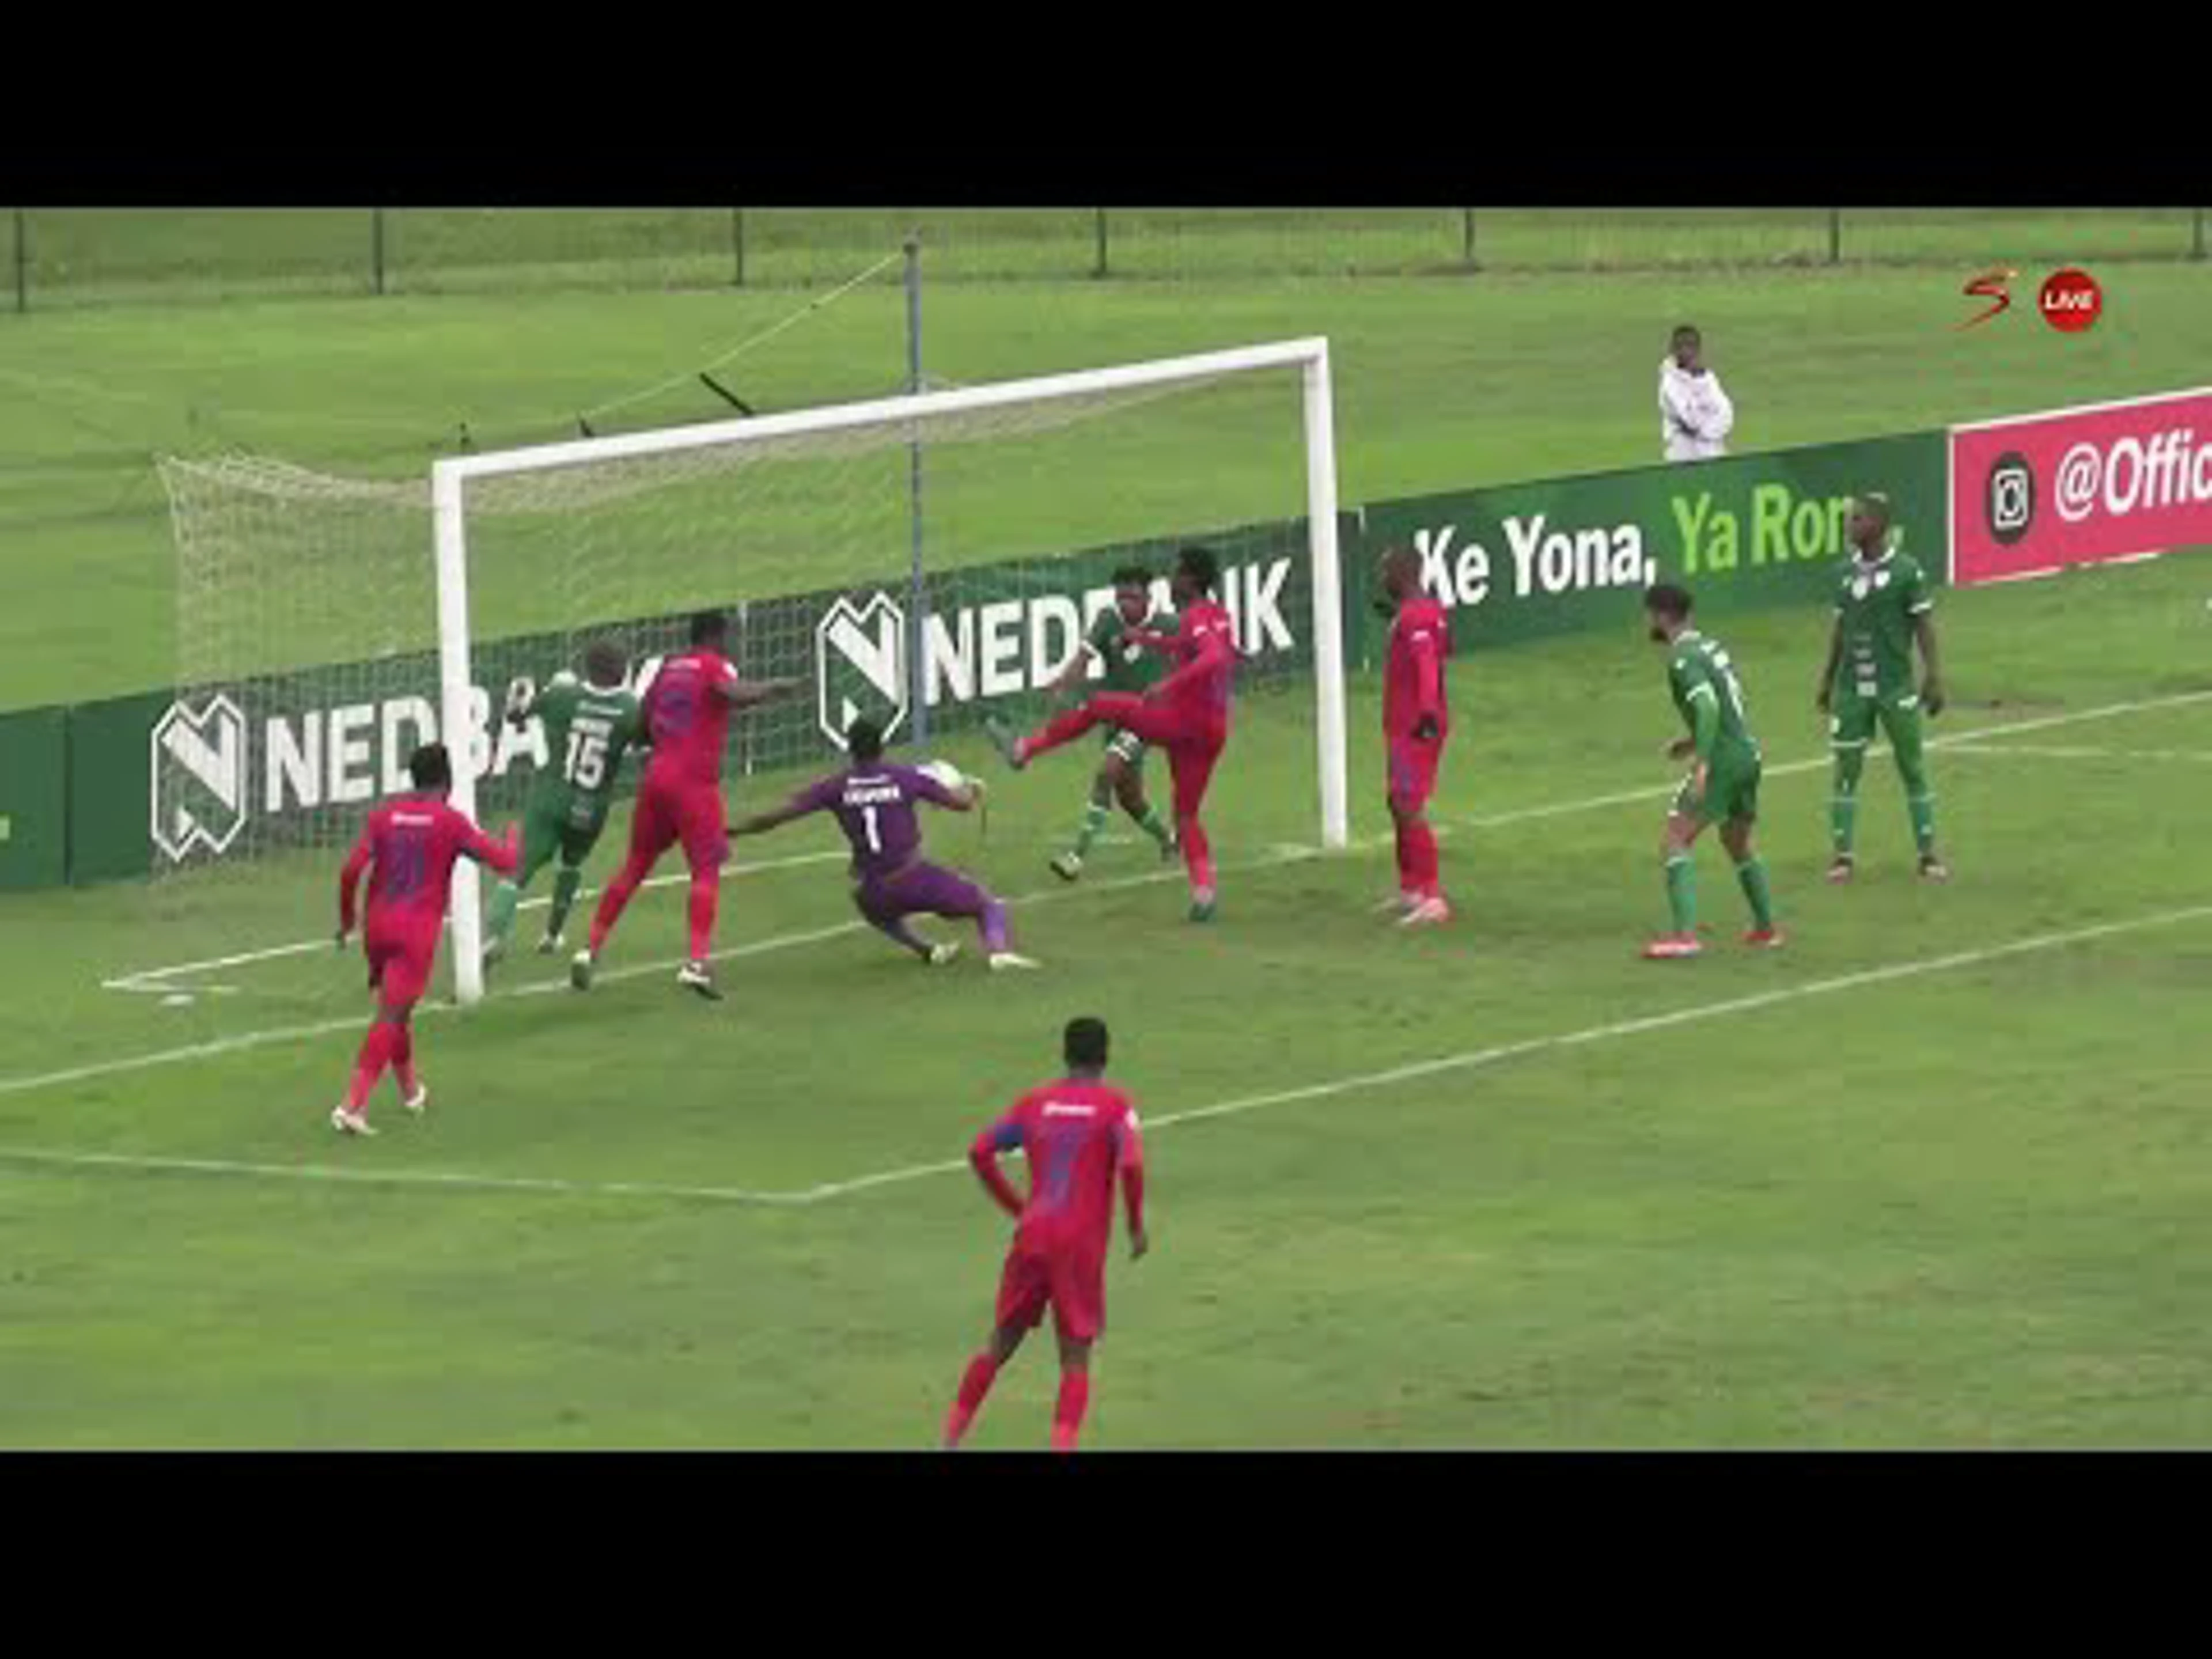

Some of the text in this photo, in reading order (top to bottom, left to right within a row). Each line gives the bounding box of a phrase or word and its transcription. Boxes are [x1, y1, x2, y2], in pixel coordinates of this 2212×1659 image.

[1415, 524, 1490, 608] Ke
[1501, 514, 1656, 597] Yona,
[1671, 491, 1737, 573] Ya
[562, 732, 608, 790] 15
[862, 805, 881, 853] 1
